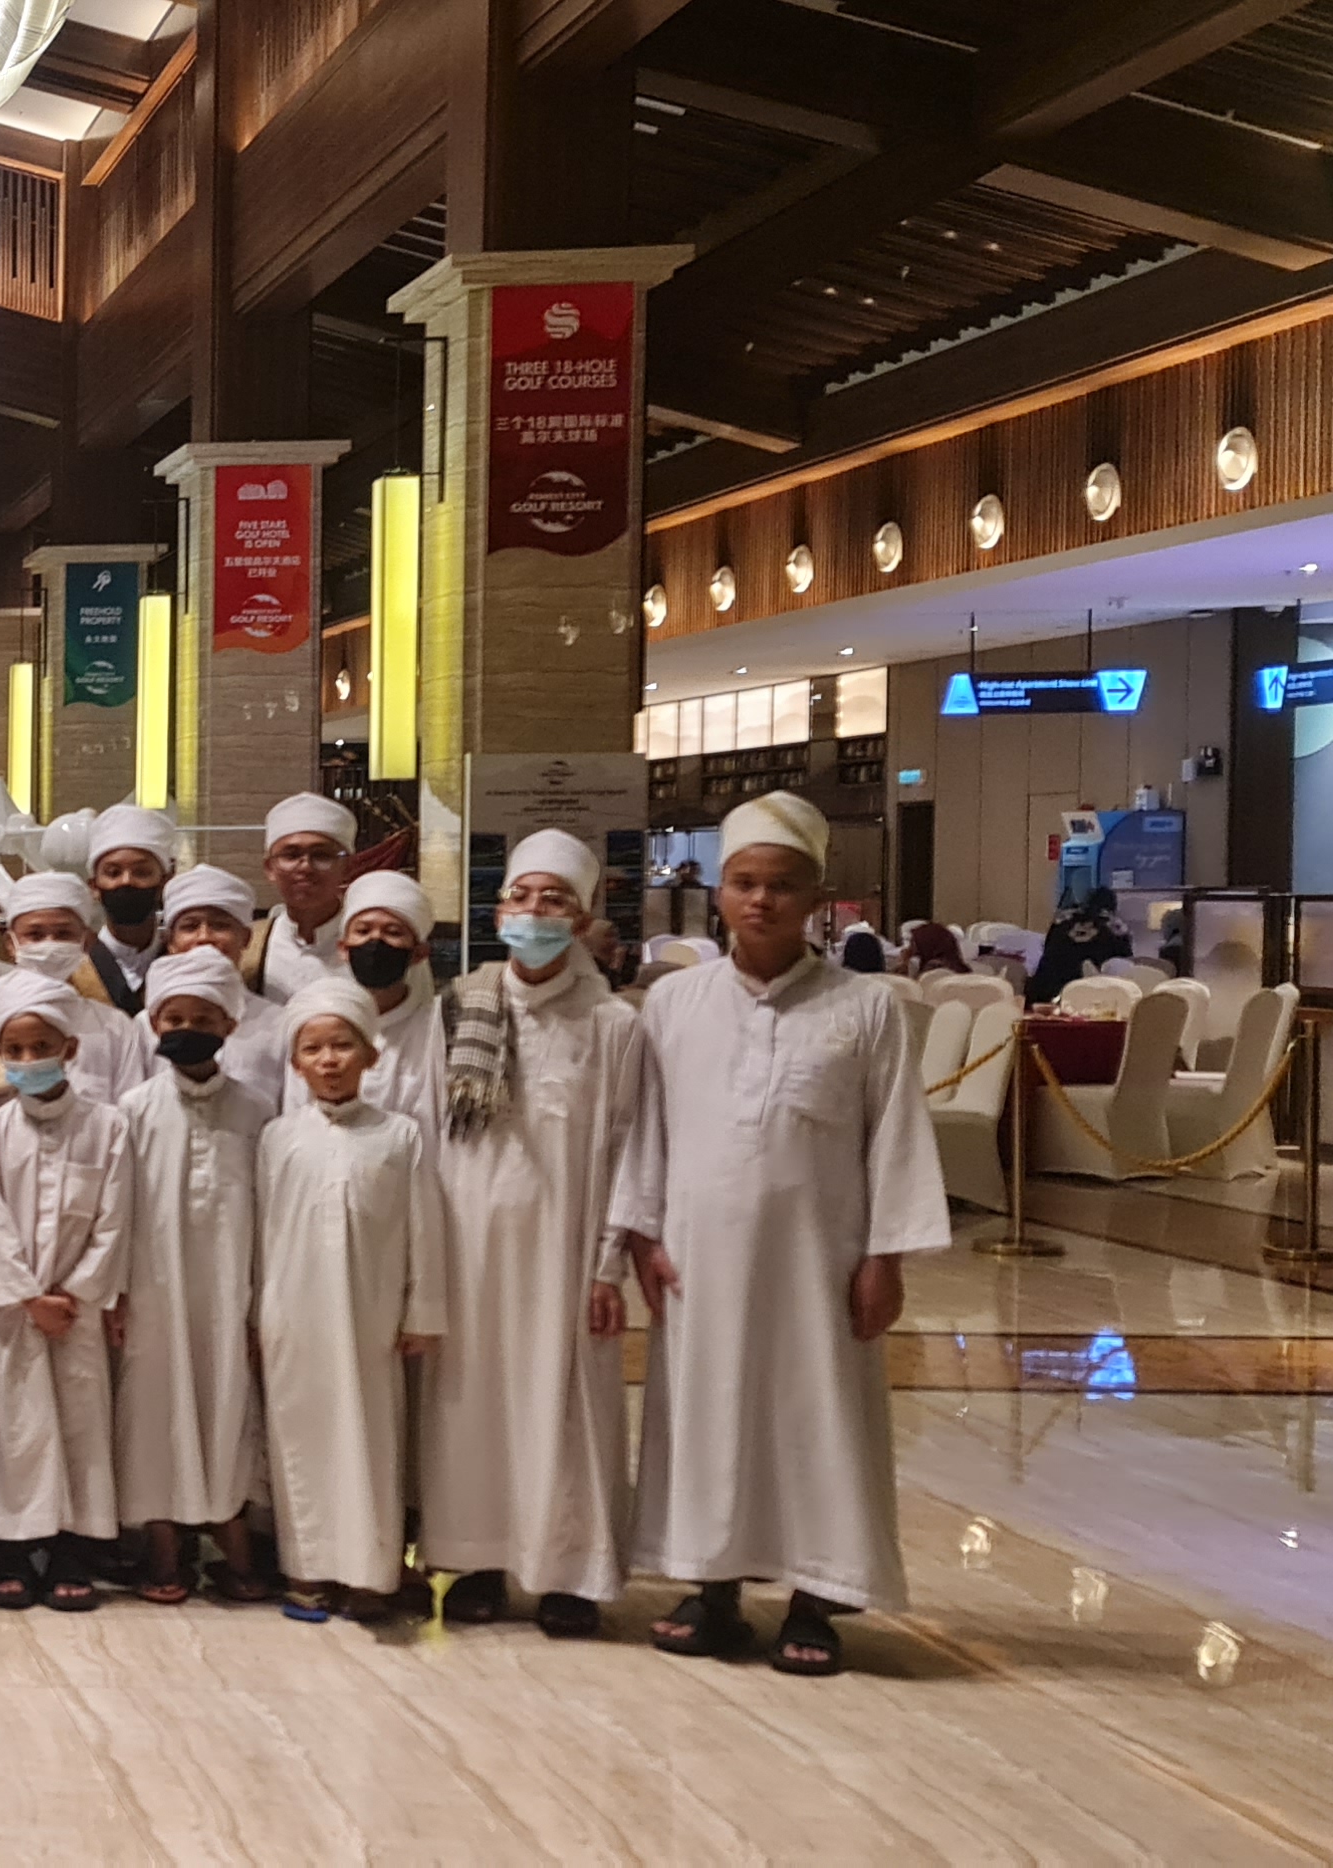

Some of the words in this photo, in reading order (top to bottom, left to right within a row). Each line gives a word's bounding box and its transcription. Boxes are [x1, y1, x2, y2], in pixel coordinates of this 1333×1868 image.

[505, 361, 549, 375] THREE
[555, 360, 617, 374] 18-HOLE
[504, 376, 544, 391] GOLF
[547, 374, 618, 389] COURSES
[510, 501, 547, 513] GOLF
[550, 500, 604, 512] RESORT
[235, 530, 260, 540] GOLF
[261, 529, 290, 539] HOTEL
[254, 539, 281, 548] OPEN
[229, 615, 255, 624] GOLF
[256, 614, 294, 623] RESORT
